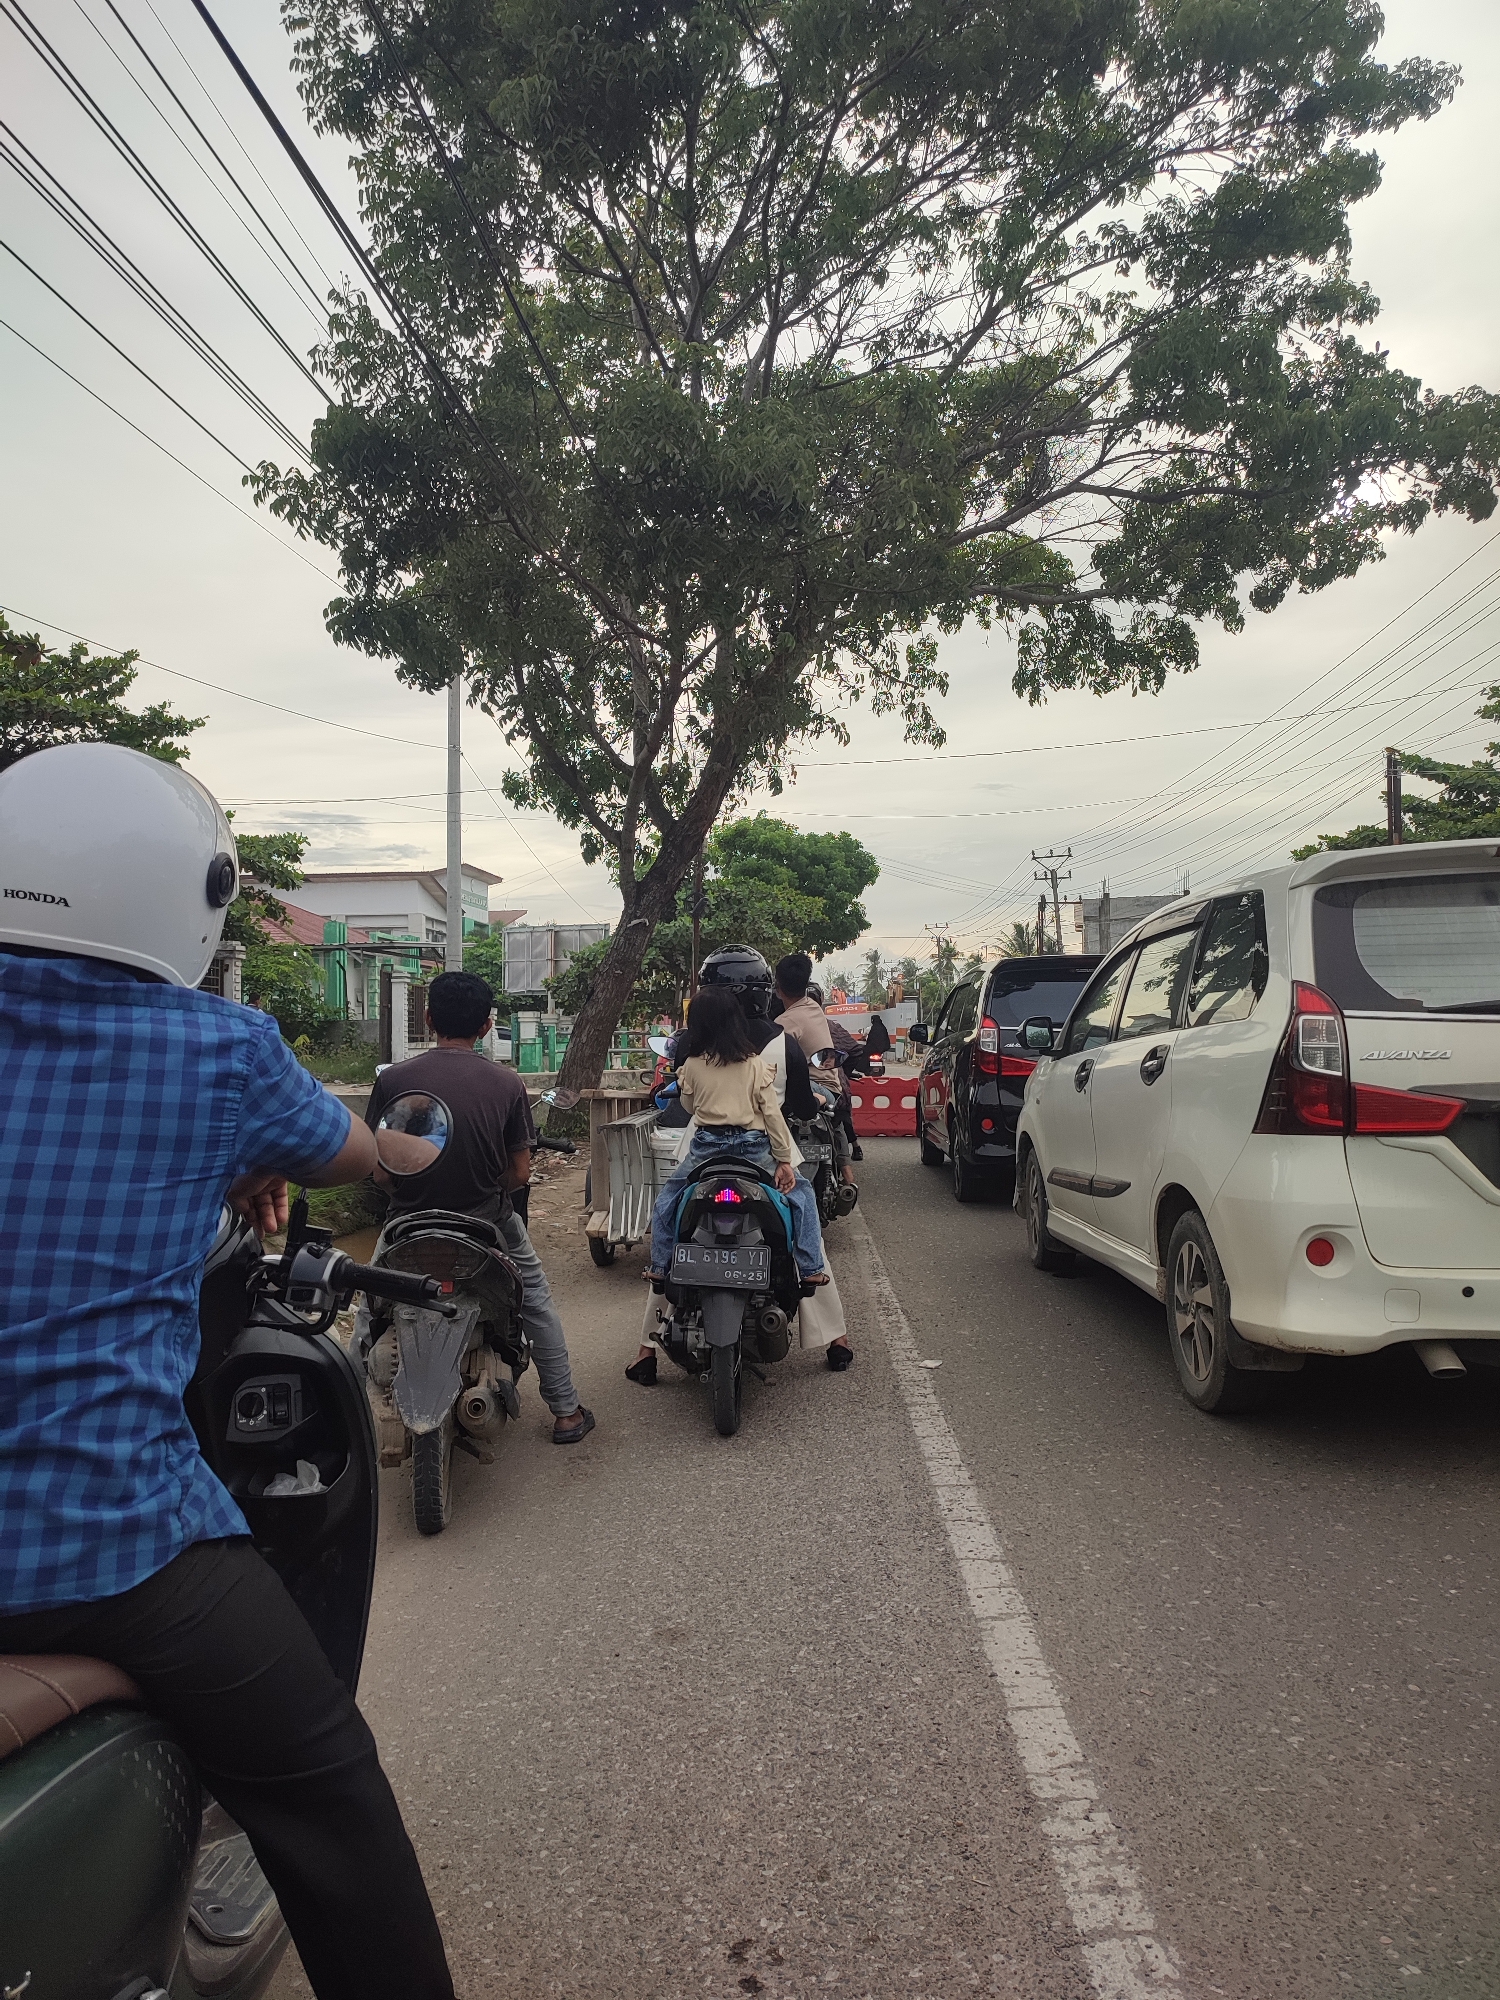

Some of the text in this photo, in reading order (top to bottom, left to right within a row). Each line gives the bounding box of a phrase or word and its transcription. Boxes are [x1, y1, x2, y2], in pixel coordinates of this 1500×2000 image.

[3, 888, 71, 908] HONDA
[1359, 1049, 1452, 1060] AVANZA
[677, 1249, 696, 1264] BL
[702, 1250, 738, 1264] 6196
